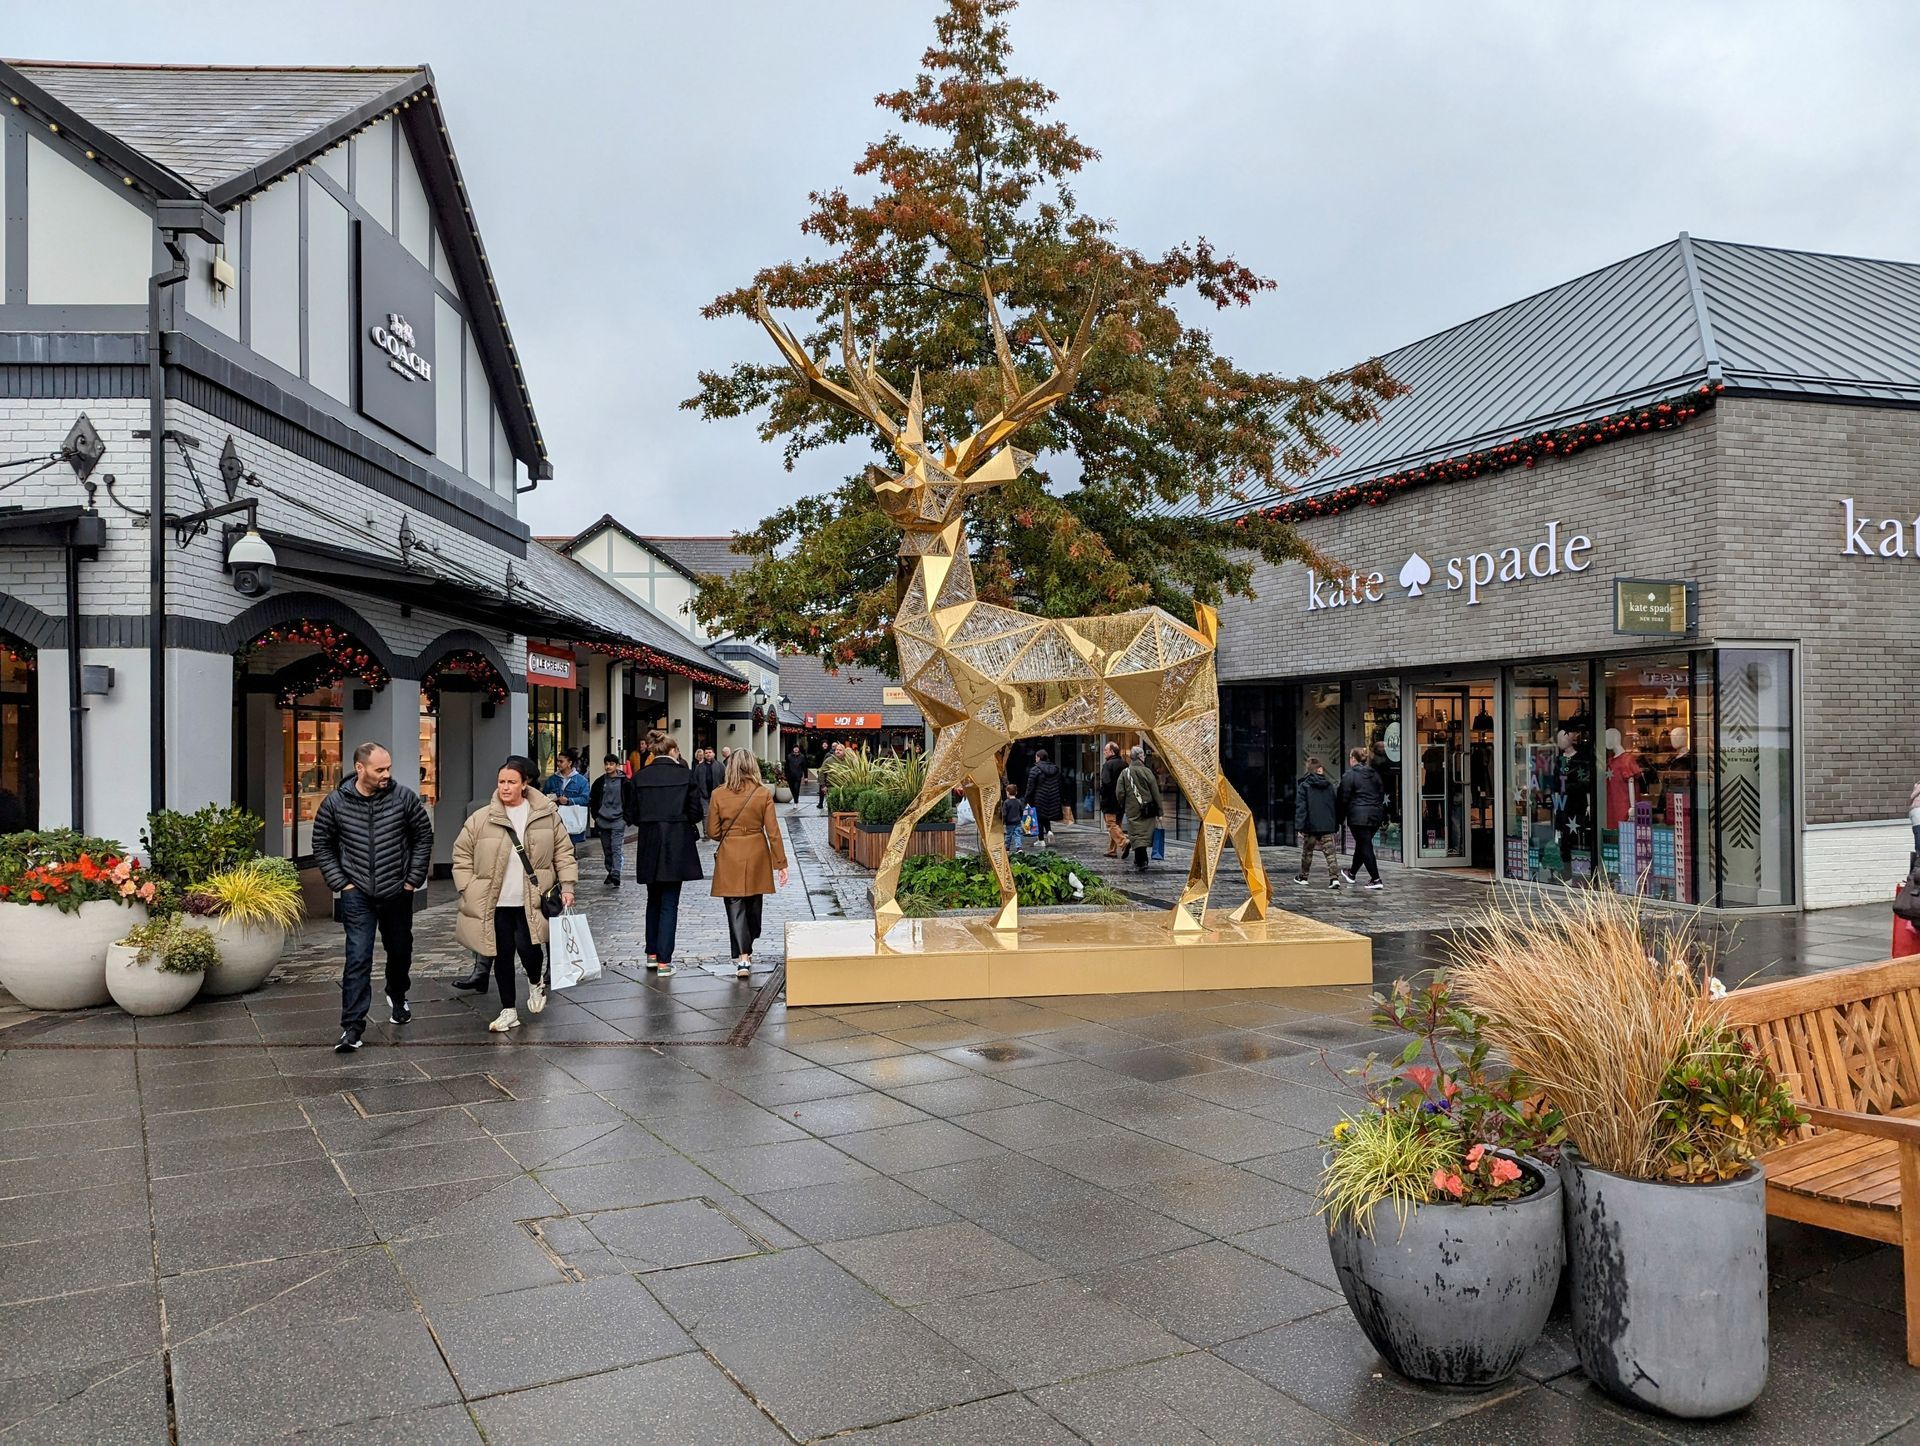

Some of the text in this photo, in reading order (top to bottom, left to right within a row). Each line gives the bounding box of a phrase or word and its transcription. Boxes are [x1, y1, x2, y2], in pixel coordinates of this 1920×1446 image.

[371, 326, 431, 382] COACH
[1307, 521, 1592, 611] kate spade
[1629, 602, 1675, 615] kate spade
[537, 658, 569, 673] LE CREUSET
